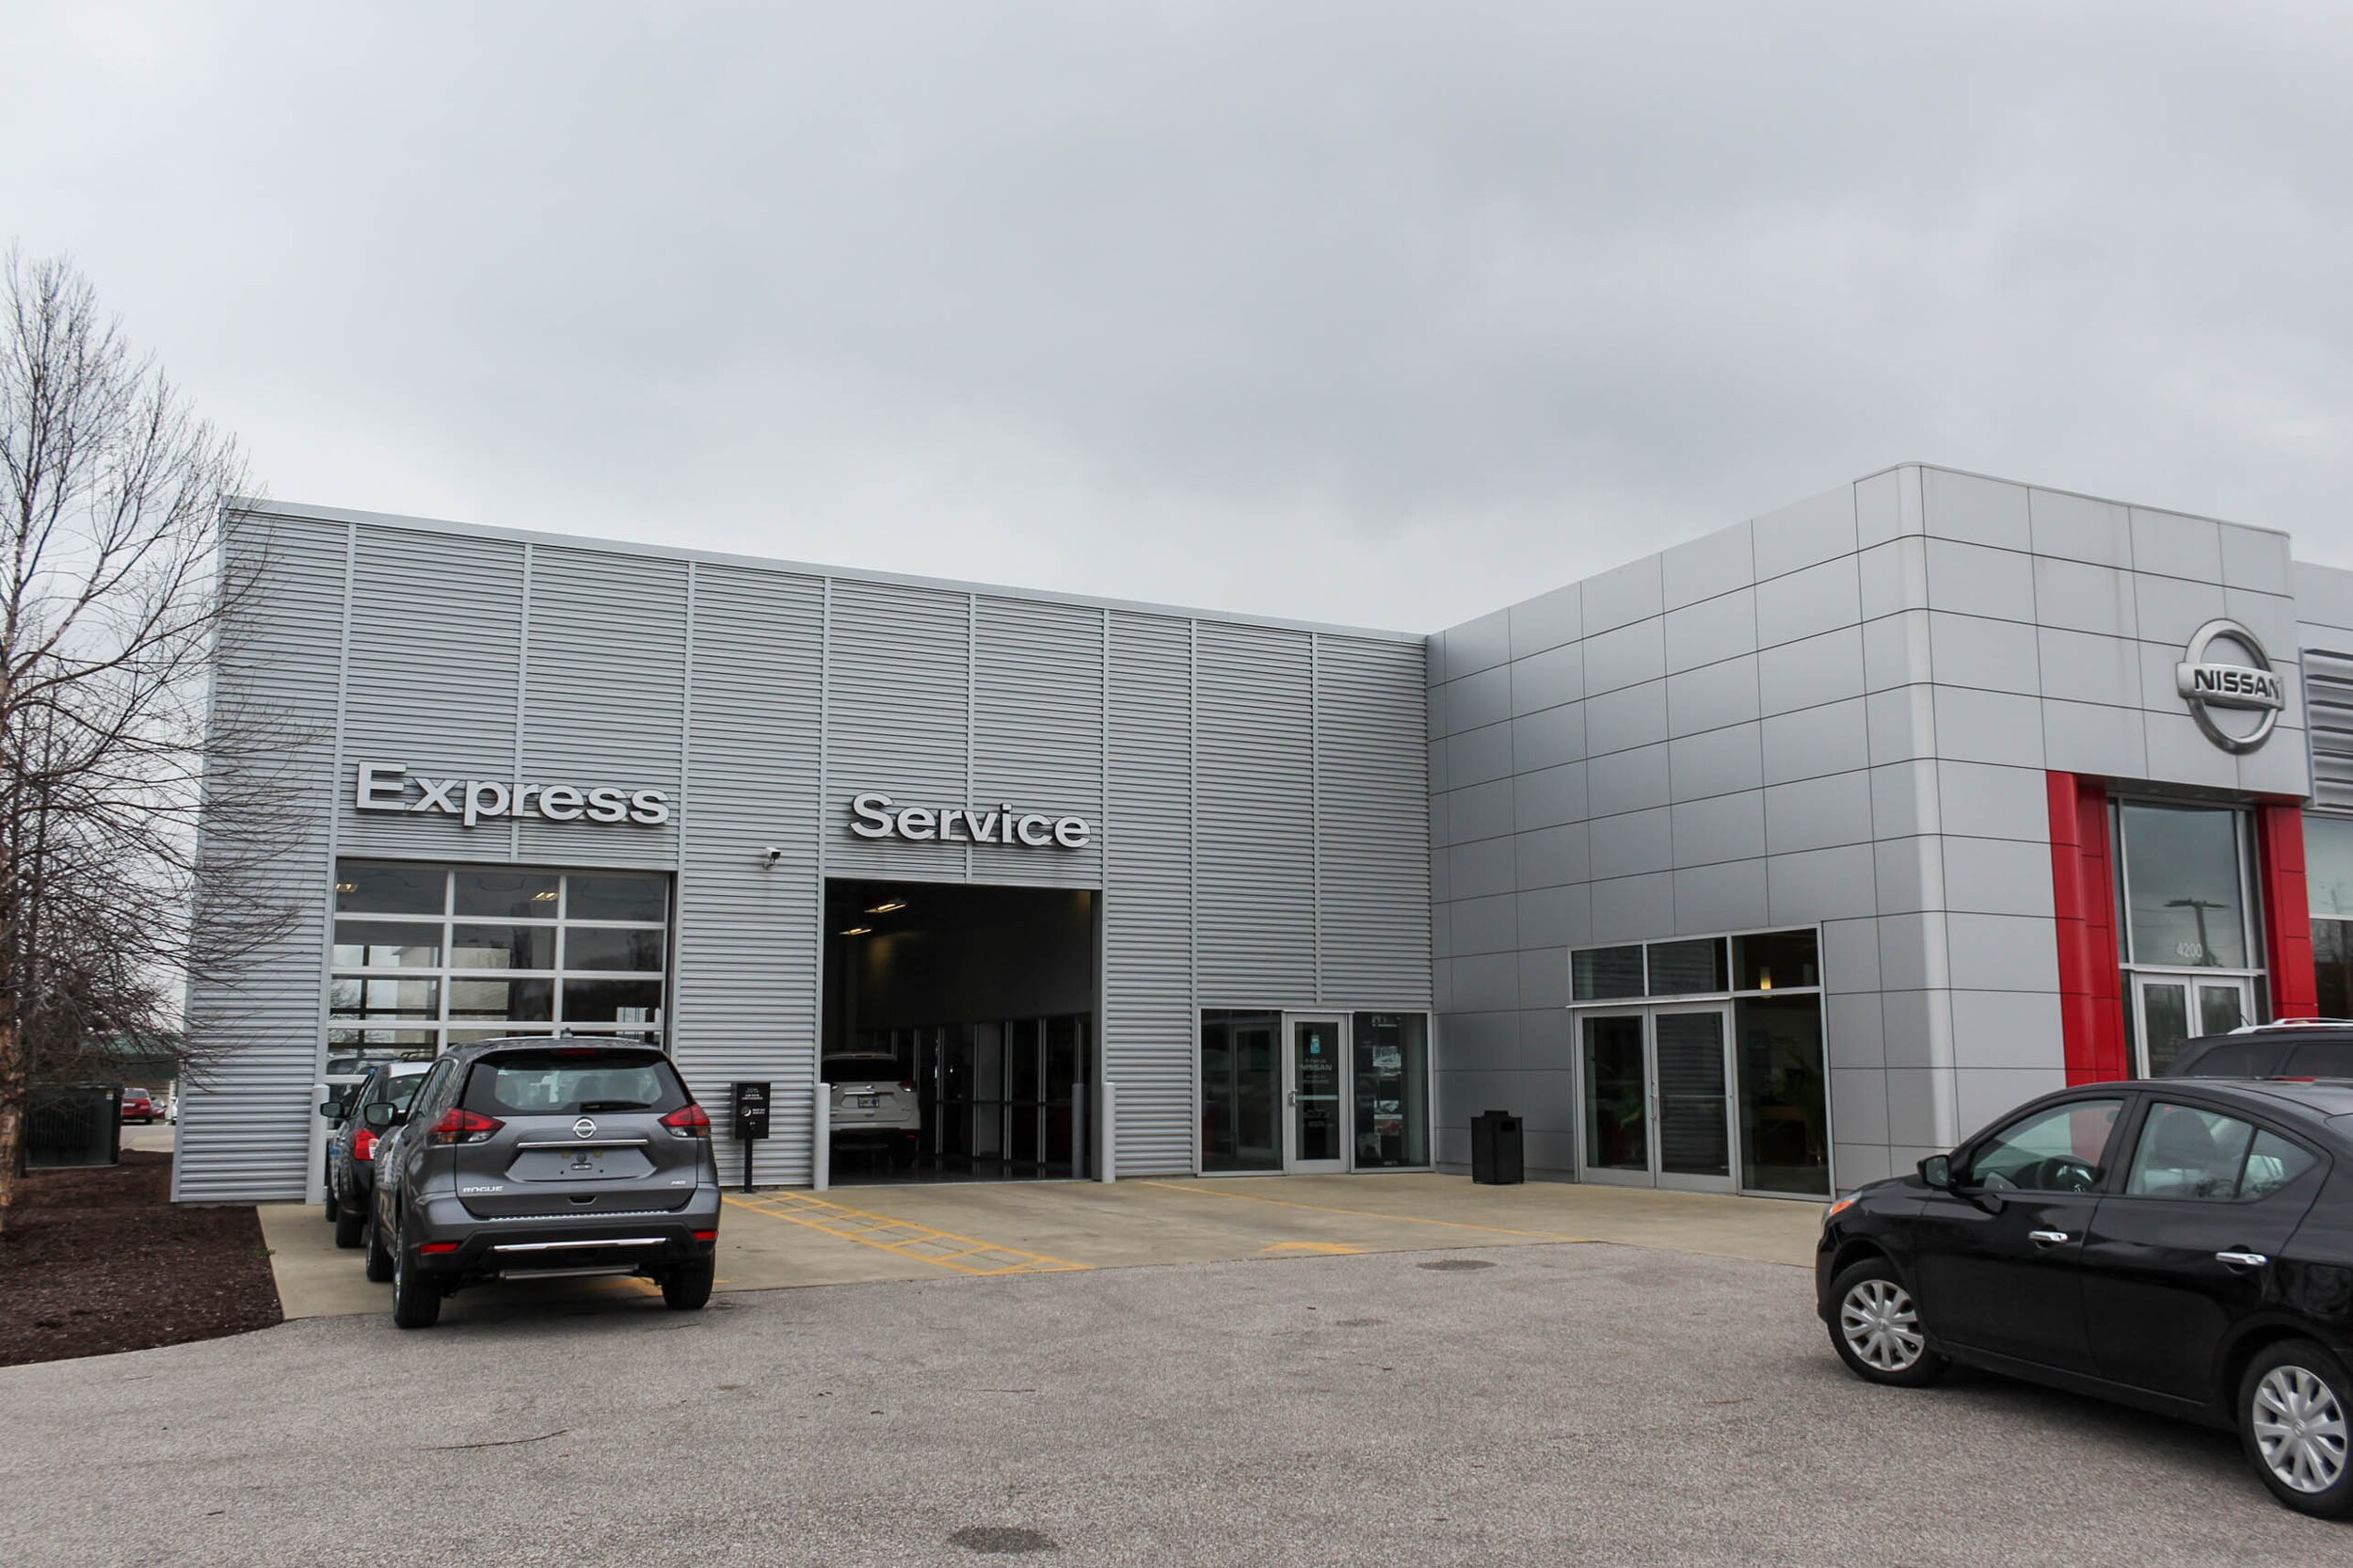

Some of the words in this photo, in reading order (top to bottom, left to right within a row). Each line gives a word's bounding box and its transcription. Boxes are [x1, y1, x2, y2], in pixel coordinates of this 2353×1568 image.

[2193, 668, 2280, 700] NISSAN
[355, 760, 671, 827] Express
[849, 792, 1092, 848] Service
[2176, 942, 2202, 957] 4200
[462, 1185, 504, 1193] ROGUE
